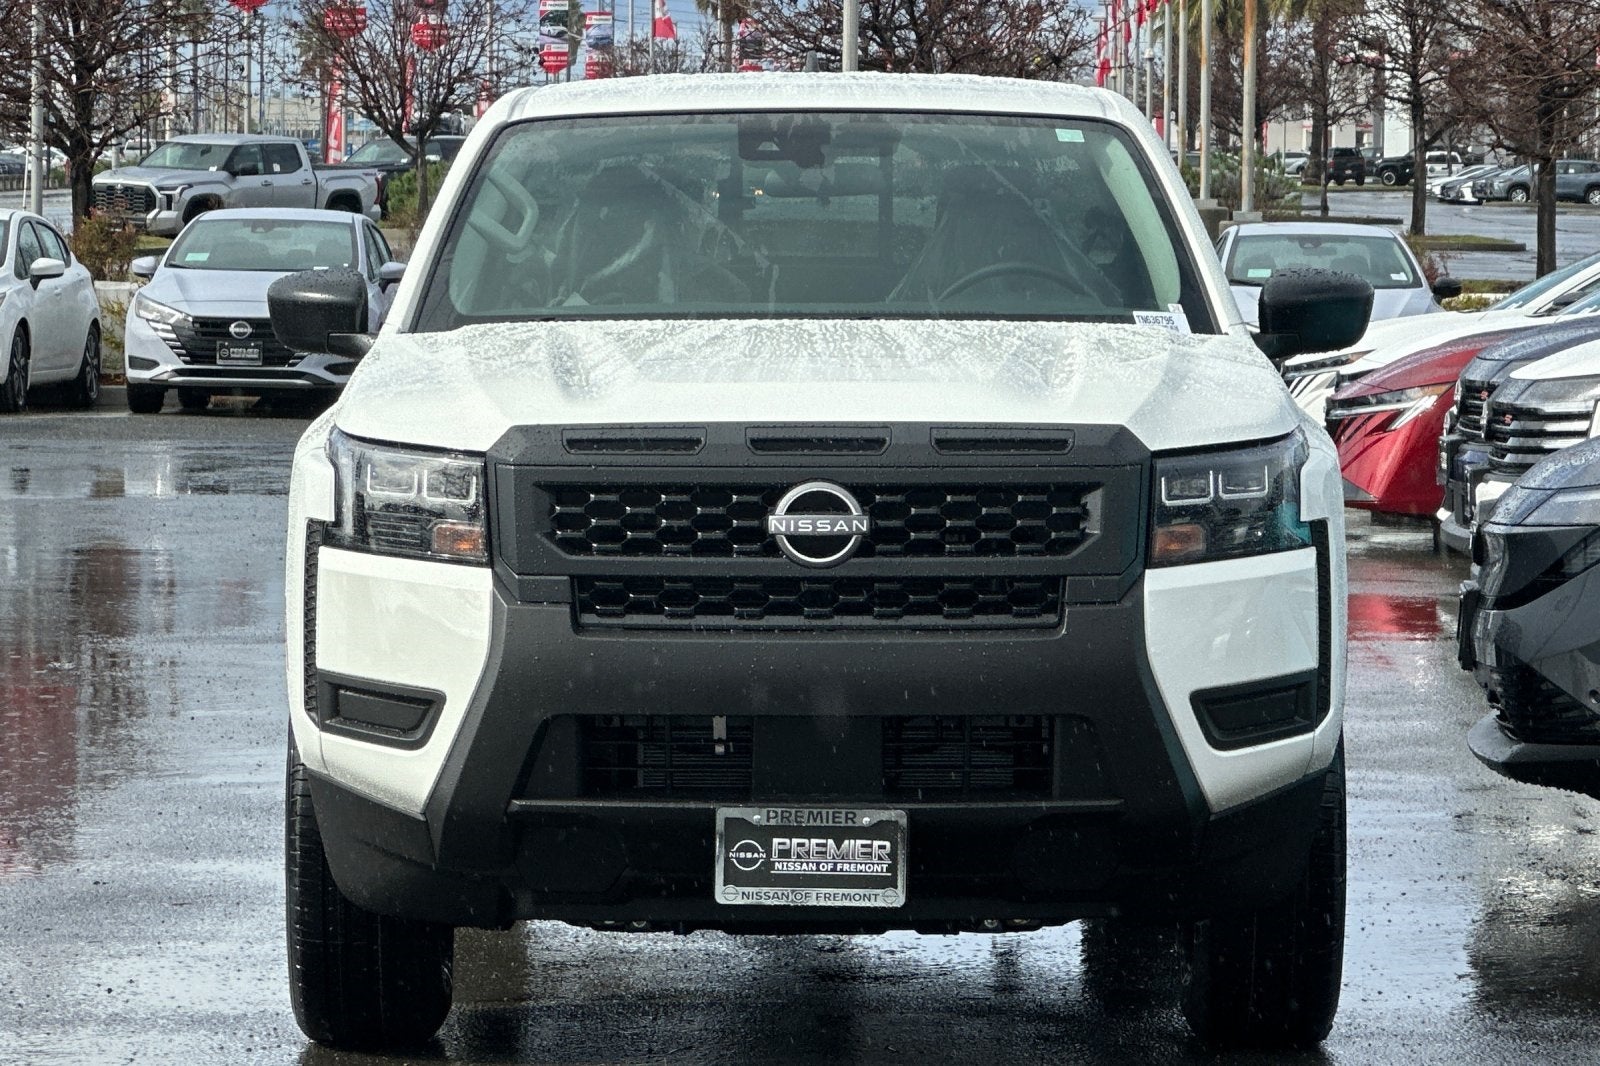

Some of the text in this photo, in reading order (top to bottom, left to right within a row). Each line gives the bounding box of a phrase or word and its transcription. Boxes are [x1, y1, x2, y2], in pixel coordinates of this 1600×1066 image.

[1136, 315, 1175, 325] TN636795
[771, 519, 867, 532] NISSAN
[766, 809, 857, 825] PREMIER
[728, 851, 767, 859] NISSAN
[771, 837, 892, 861] PREMIER
[774, 861, 889, 873] NISSAN OF FREMONT
[741, 891, 790, 901] NISSAN
[793, 892, 812, 902] OF
[815, 892, 881, 903] FREMONT
